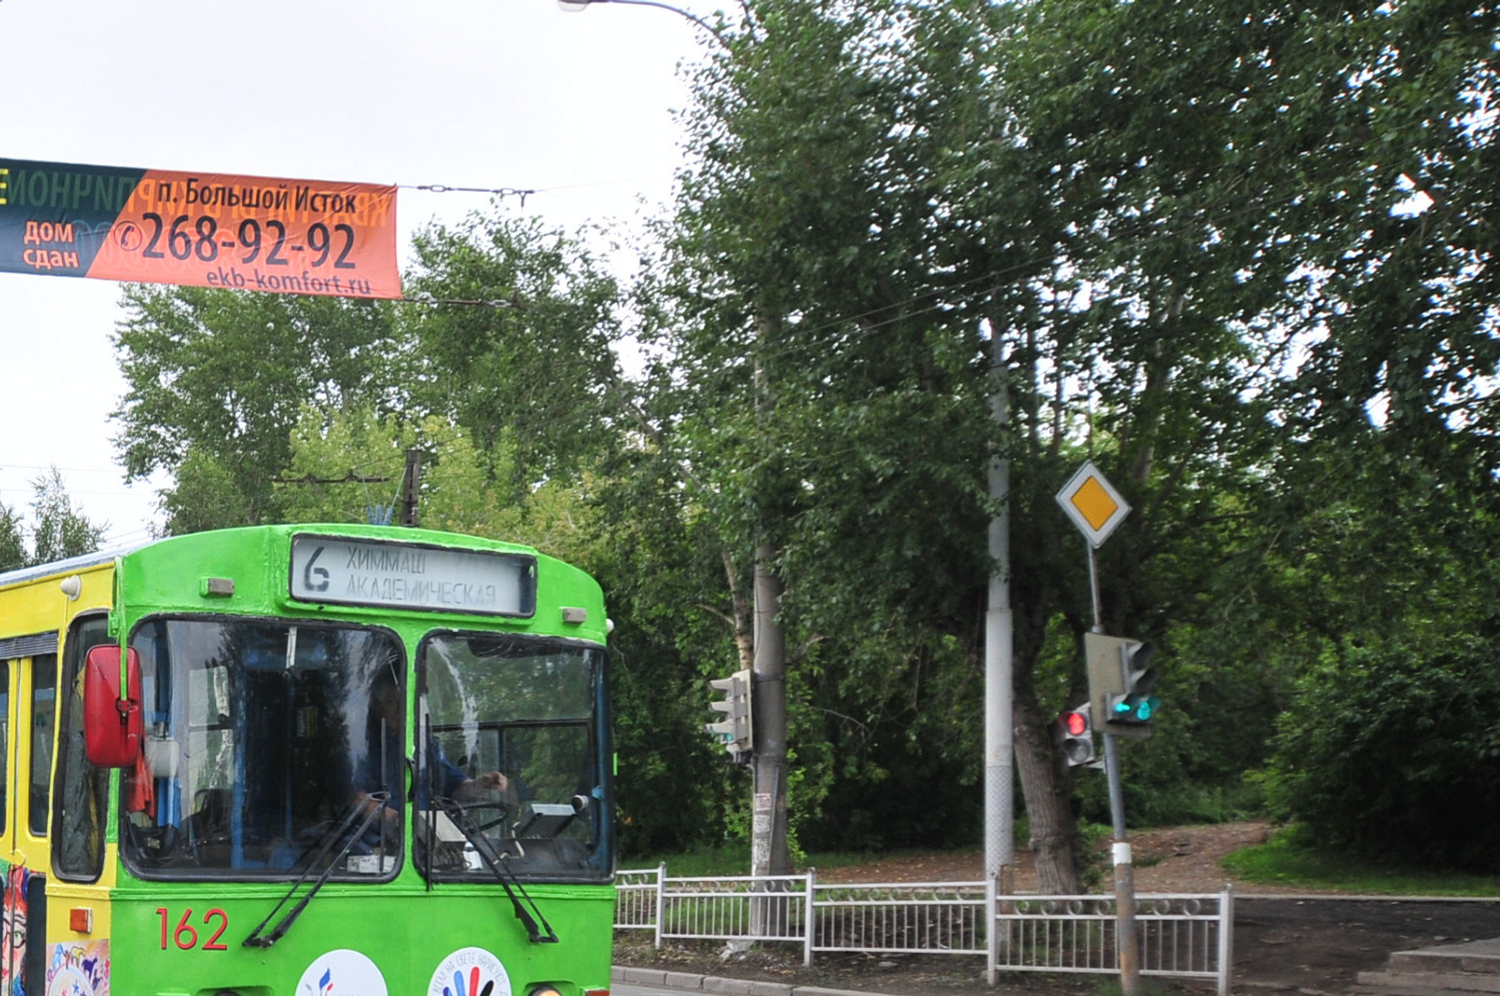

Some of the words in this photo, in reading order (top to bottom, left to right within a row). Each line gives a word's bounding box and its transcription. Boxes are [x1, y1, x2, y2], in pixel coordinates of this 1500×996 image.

[158, 184, 179, 204] п.
[185, 178, 290, 212] Большой
[294, 185, 356, 213] Исток
[23, 219, 74, 246] дом
[143, 212, 356, 269] 268-92-92
[23, 248, 79, 269] сдан
[207, 268, 371, 296] ekb-komfort.ru
[303, 546, 329, 592] 6
[347, 546, 426, 575] ХИММАШ
[347, 574, 496, 606] АКАДЕМИЧЕСКАЯ
[156, 908, 228, 950] 162
